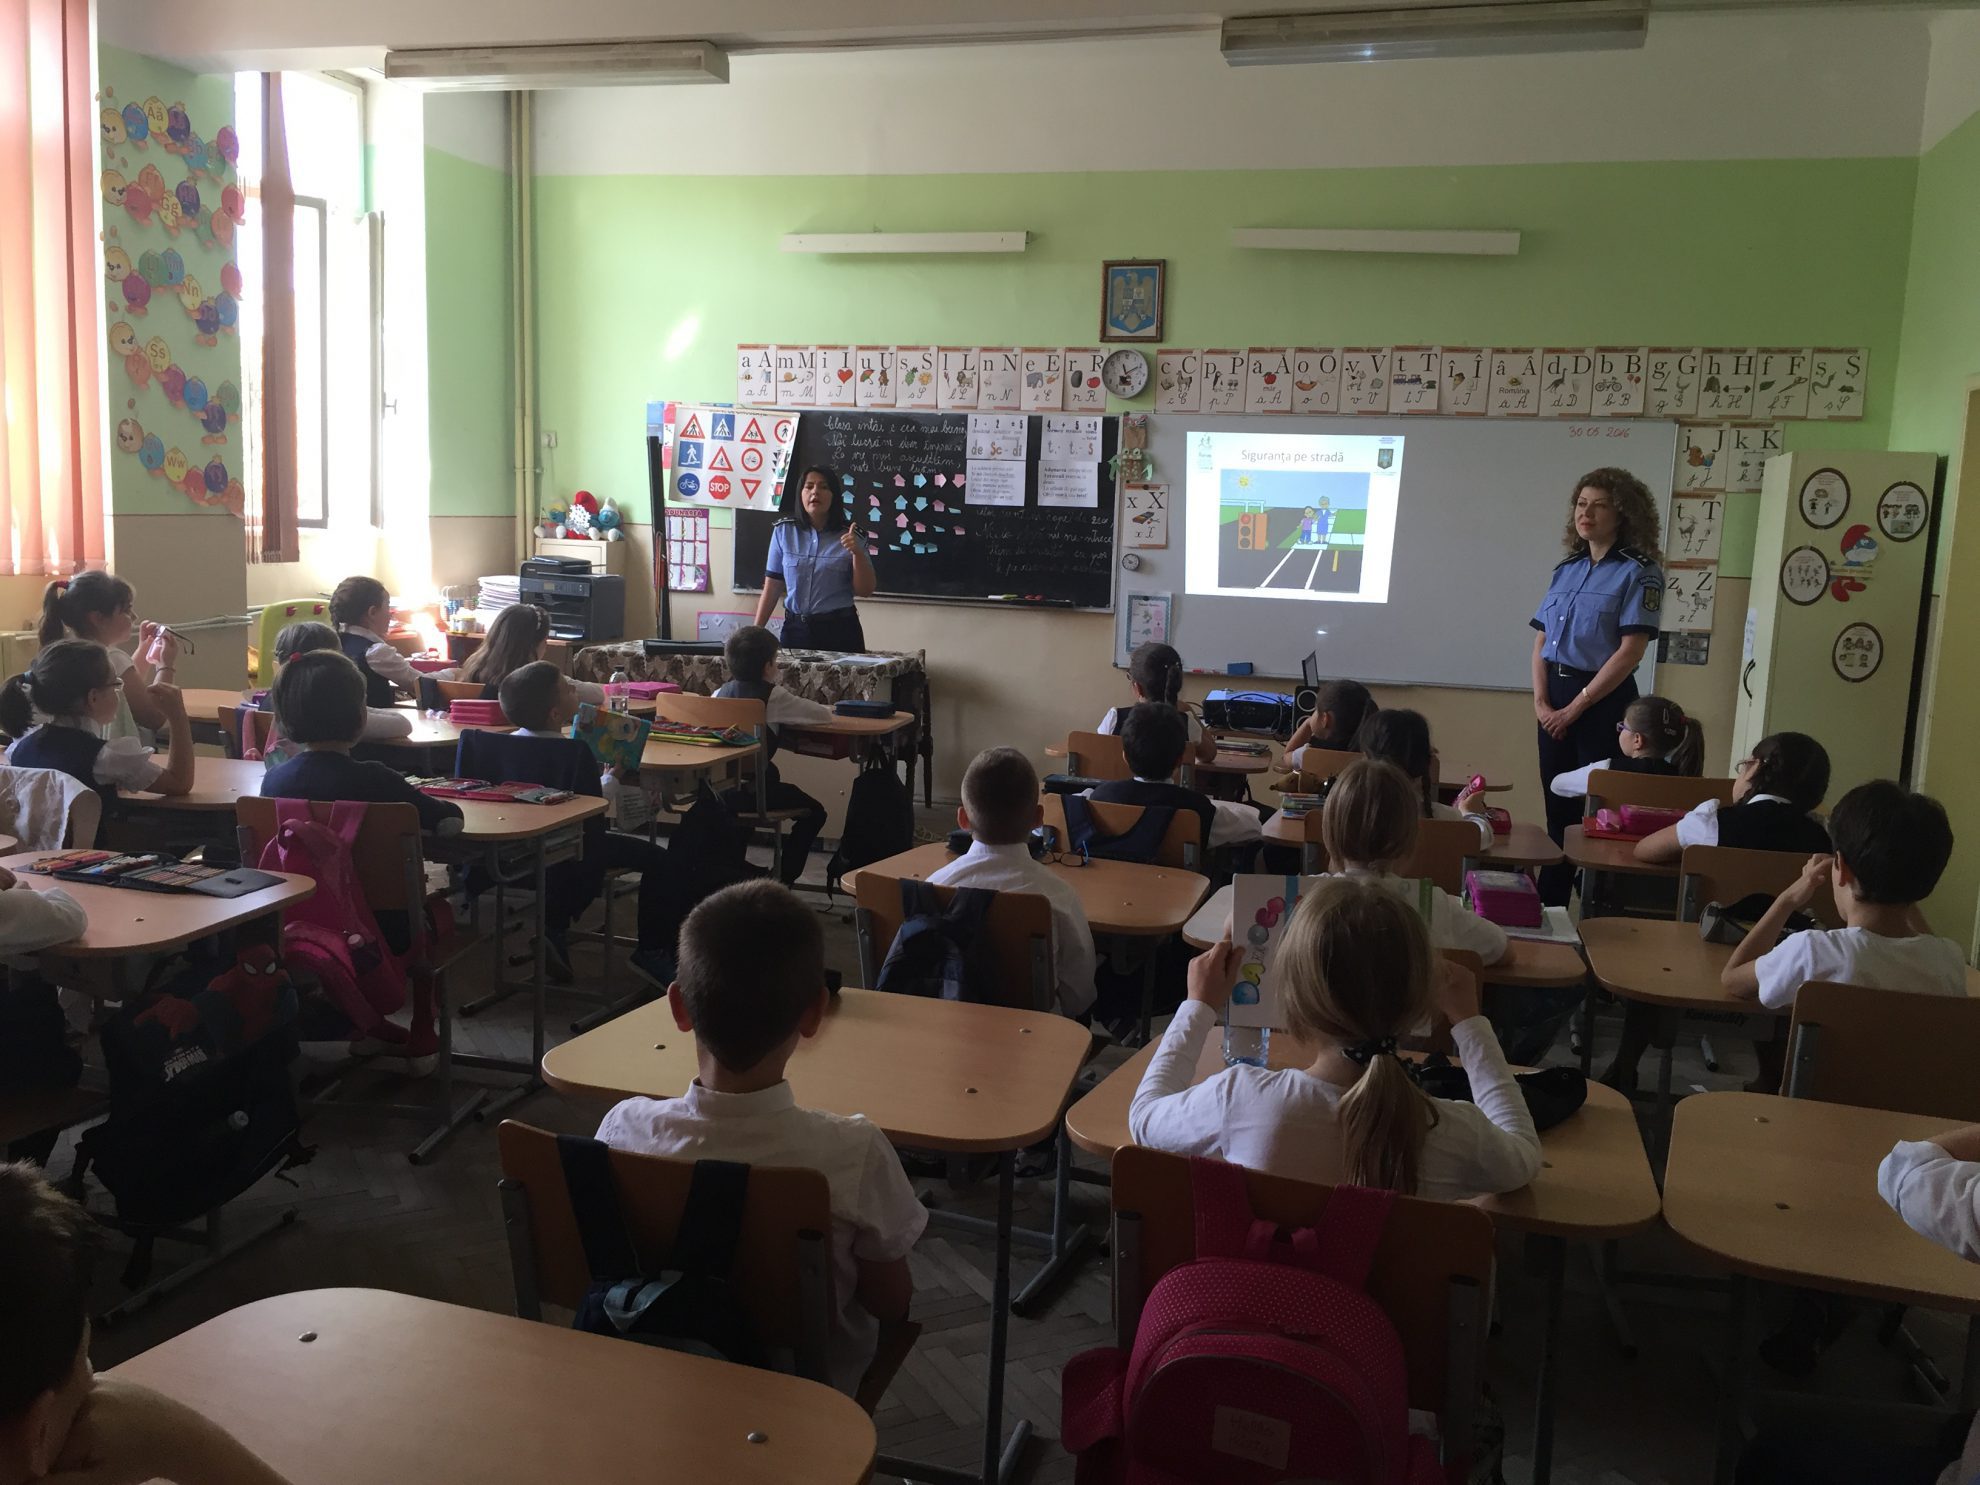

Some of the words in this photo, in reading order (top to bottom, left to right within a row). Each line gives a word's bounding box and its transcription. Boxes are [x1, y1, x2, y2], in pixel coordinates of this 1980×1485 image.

[183, 281, 200, 298] Nn
[741, 356, 751, 368] a
[758, 352, 772, 367] A
[778, 357, 794, 368] m
[798, 352, 815, 368] M
[822, 352, 827, 368] i
[842, 352, 849, 368] I
[861, 358, 871, 369] u
[880, 353, 894, 370] U
[900, 358, 908, 369] s
[922, 353, 933, 370] S
[943, 354, 948, 370] l
[962, 354, 975, 370] L
[983, 360, 994, 371] n
[1001, 354, 1019, 371] N
[1026, 360, 1035, 372] e
[1046, 355, 1060, 372] E
[1069, 360, 1077, 372] r
[1091, 355, 1104, 372] R
[1161, 362, 1171, 374] c
[1181, 356, 1197, 375] C
[1204, 363, 1218, 380] p
[1230, 357, 1244, 374] P
[1298, 361, 1309, 373] o
[1320, 355, 1336, 374] O
[1348, 361, 1359, 374] v
[1371, 355, 1386, 373] V
[1398, 356, 1406, 372] t
[1420, 354, 1437, 372] T
[1448, 360, 1456, 377] î
[1472, 354, 1483, 378] Î
[1496, 360, 1506, 375] â
[1522, 356, 1537, 376] Â
[1547, 355, 1560, 374] d
[1573, 355, 1592, 374] D
[1600, 354, 1614, 374] b
[1624, 355, 1641, 374] B
[1653, 362, 1667, 379] g
[1677, 354, 1697, 375] G
[1707, 355, 1720, 375] h
[1733, 355, 1754, 375] H
[1762, 355, 1773, 375] f
[1787, 356, 1805, 375] F
[1499, 387, 1530, 395] România
[1682, 429, 1691, 453] j
[1712, 429, 1727, 453] J
[1734, 429, 1750, 449] k
[1762, 430, 1779, 449] K
[1294, 453, 1308, 463] pe
[1310, 452, 1344, 463] stradă
[708, 482, 730, 493] STOP
[1126, 497, 1138, 508] x
[1148, 491, 1165, 509] X
[1667, 577, 1680, 590] z
[1696, 571, 1712, 591] Z
